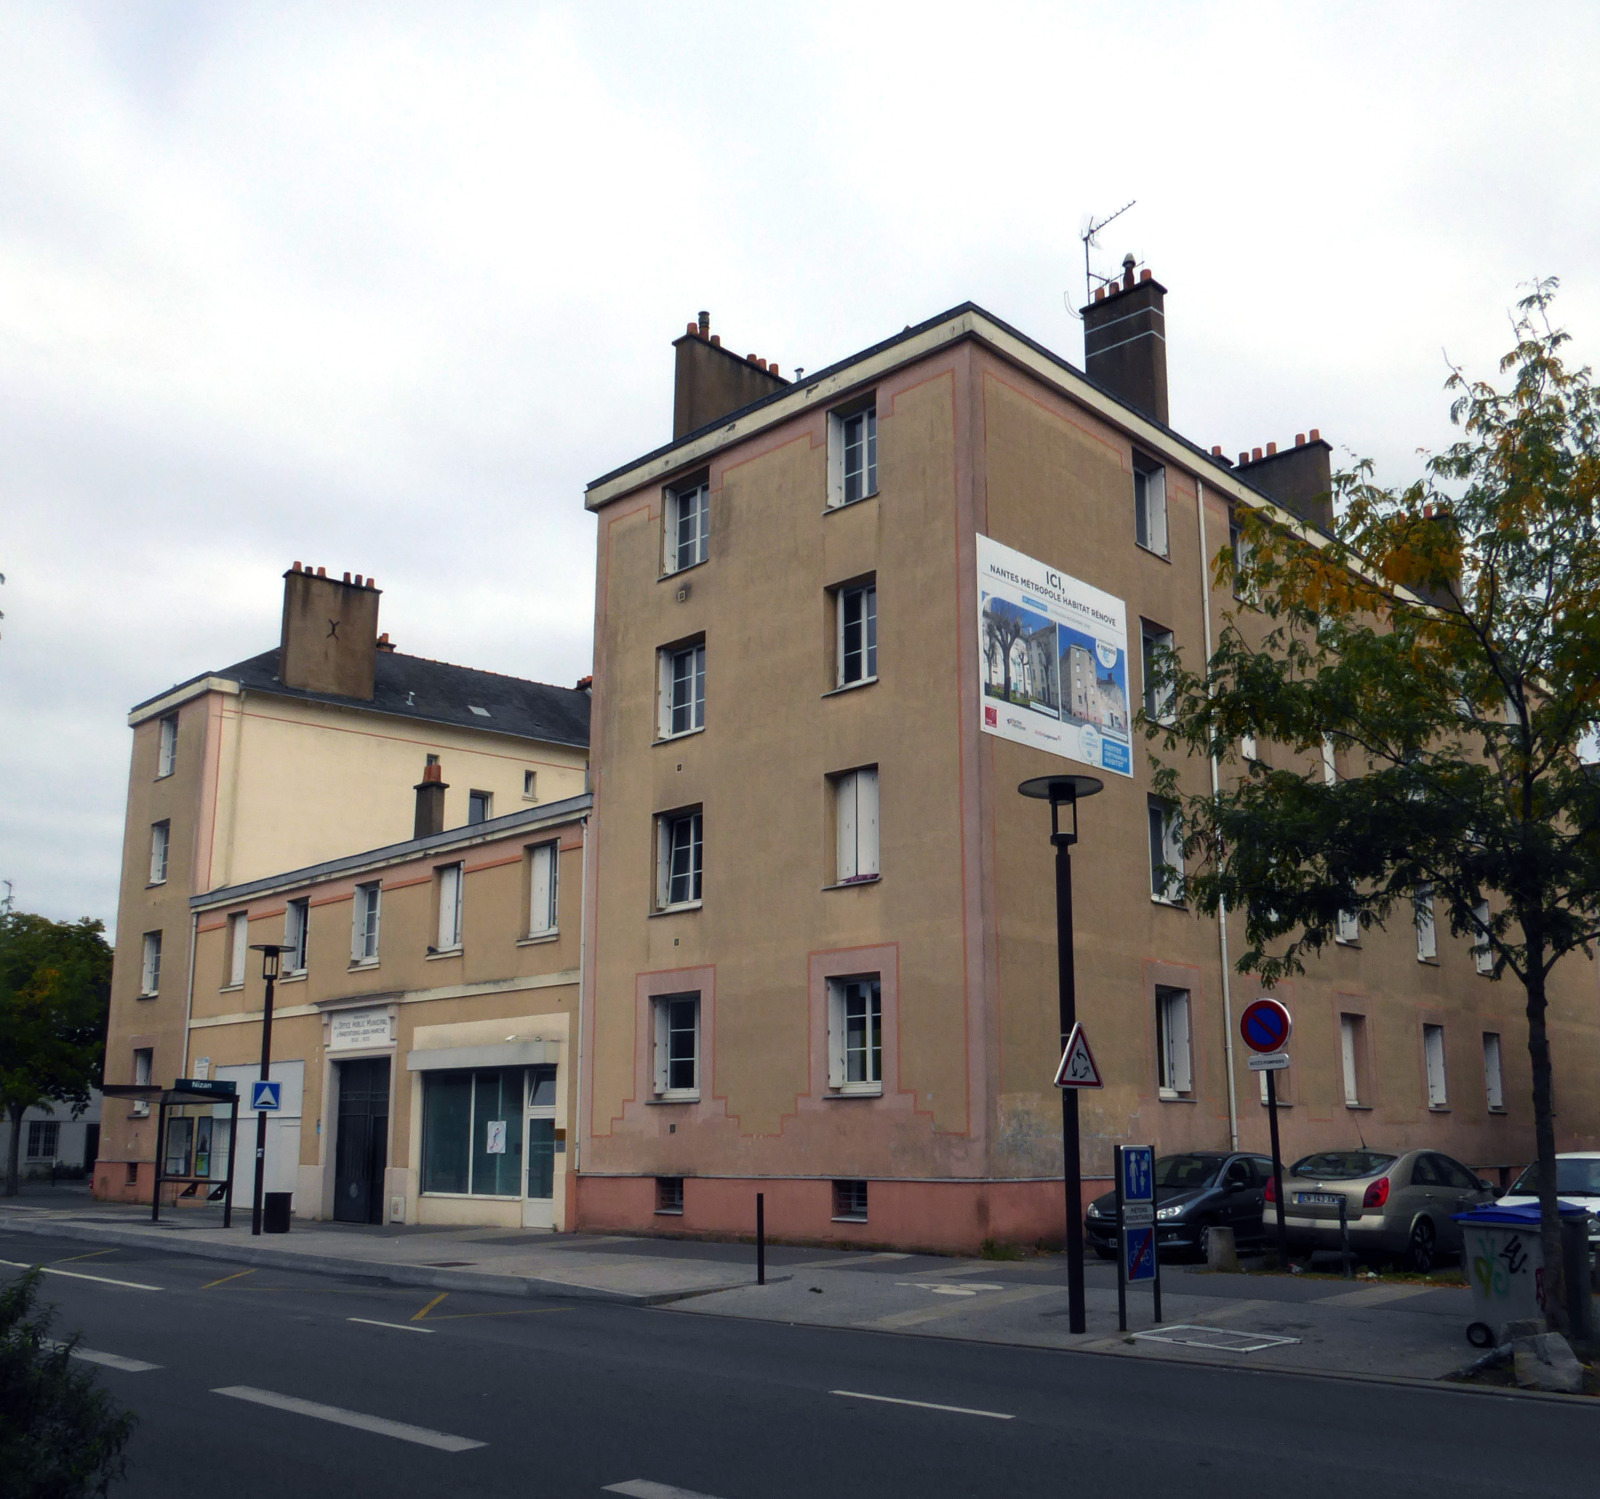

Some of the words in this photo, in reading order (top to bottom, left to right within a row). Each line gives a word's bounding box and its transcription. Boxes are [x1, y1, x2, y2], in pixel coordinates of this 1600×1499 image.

[1046, 571, 1066, 595] ICI,
[990, 564, 1019, 583] NANTES
[1020, 577, 1061, 603] MÉTROPOLE
[1063, 595, 1090, 614] HABITAT
[1091, 608, 1117, 627] RÉNOVE
[192, 1081, 212, 1089] Nizan
